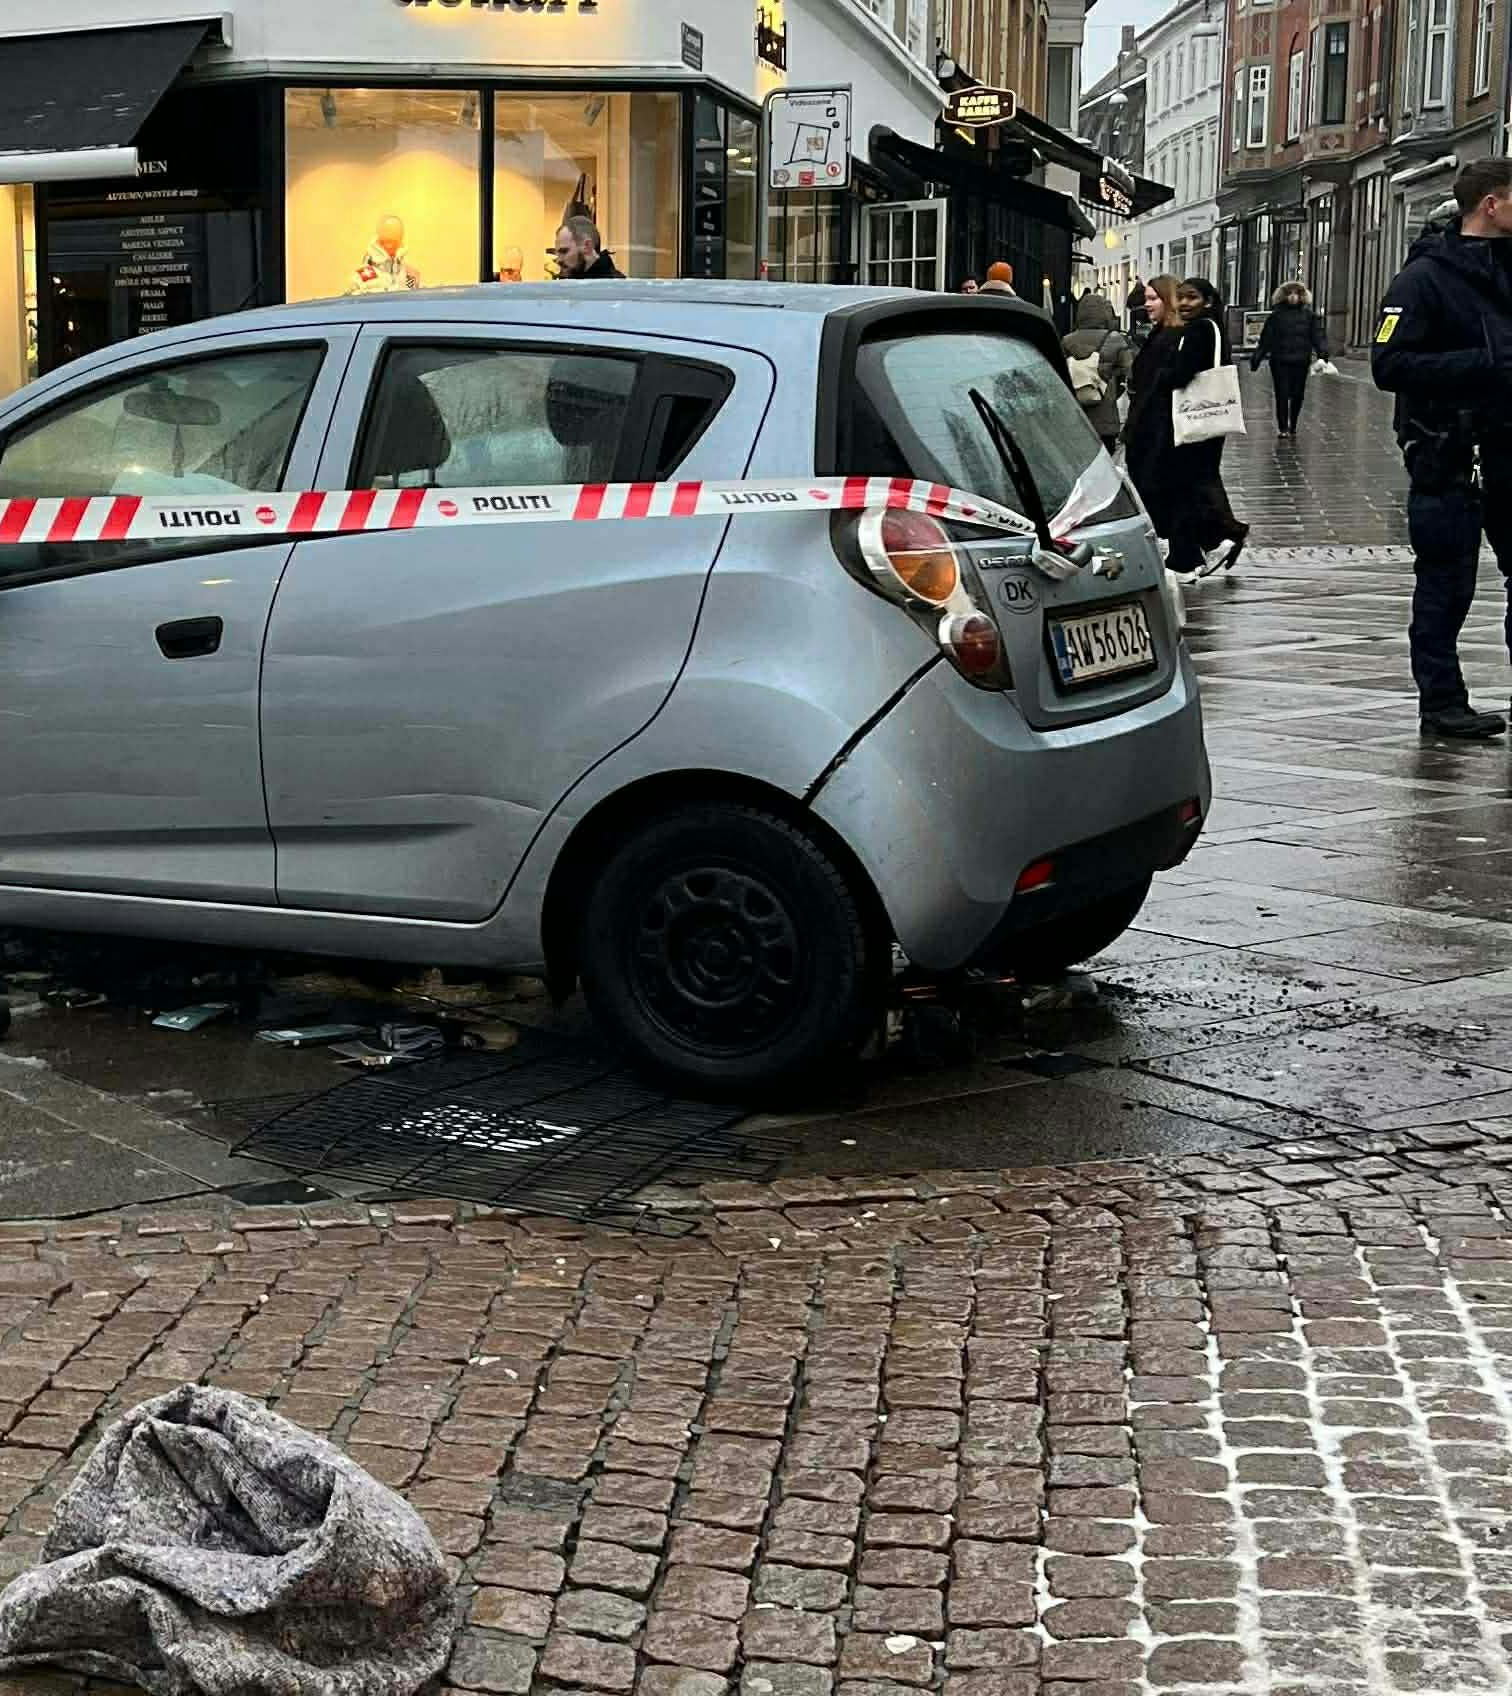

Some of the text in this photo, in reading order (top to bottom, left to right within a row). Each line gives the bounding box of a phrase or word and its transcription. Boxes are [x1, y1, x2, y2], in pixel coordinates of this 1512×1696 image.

[960, 95, 999, 107] KAFFE
[137, 160, 168, 175] MEN
[472, 495, 552, 511] POLITI
[159, 510, 241, 528] POLITI
[1004, 580, 1033, 602] DK
